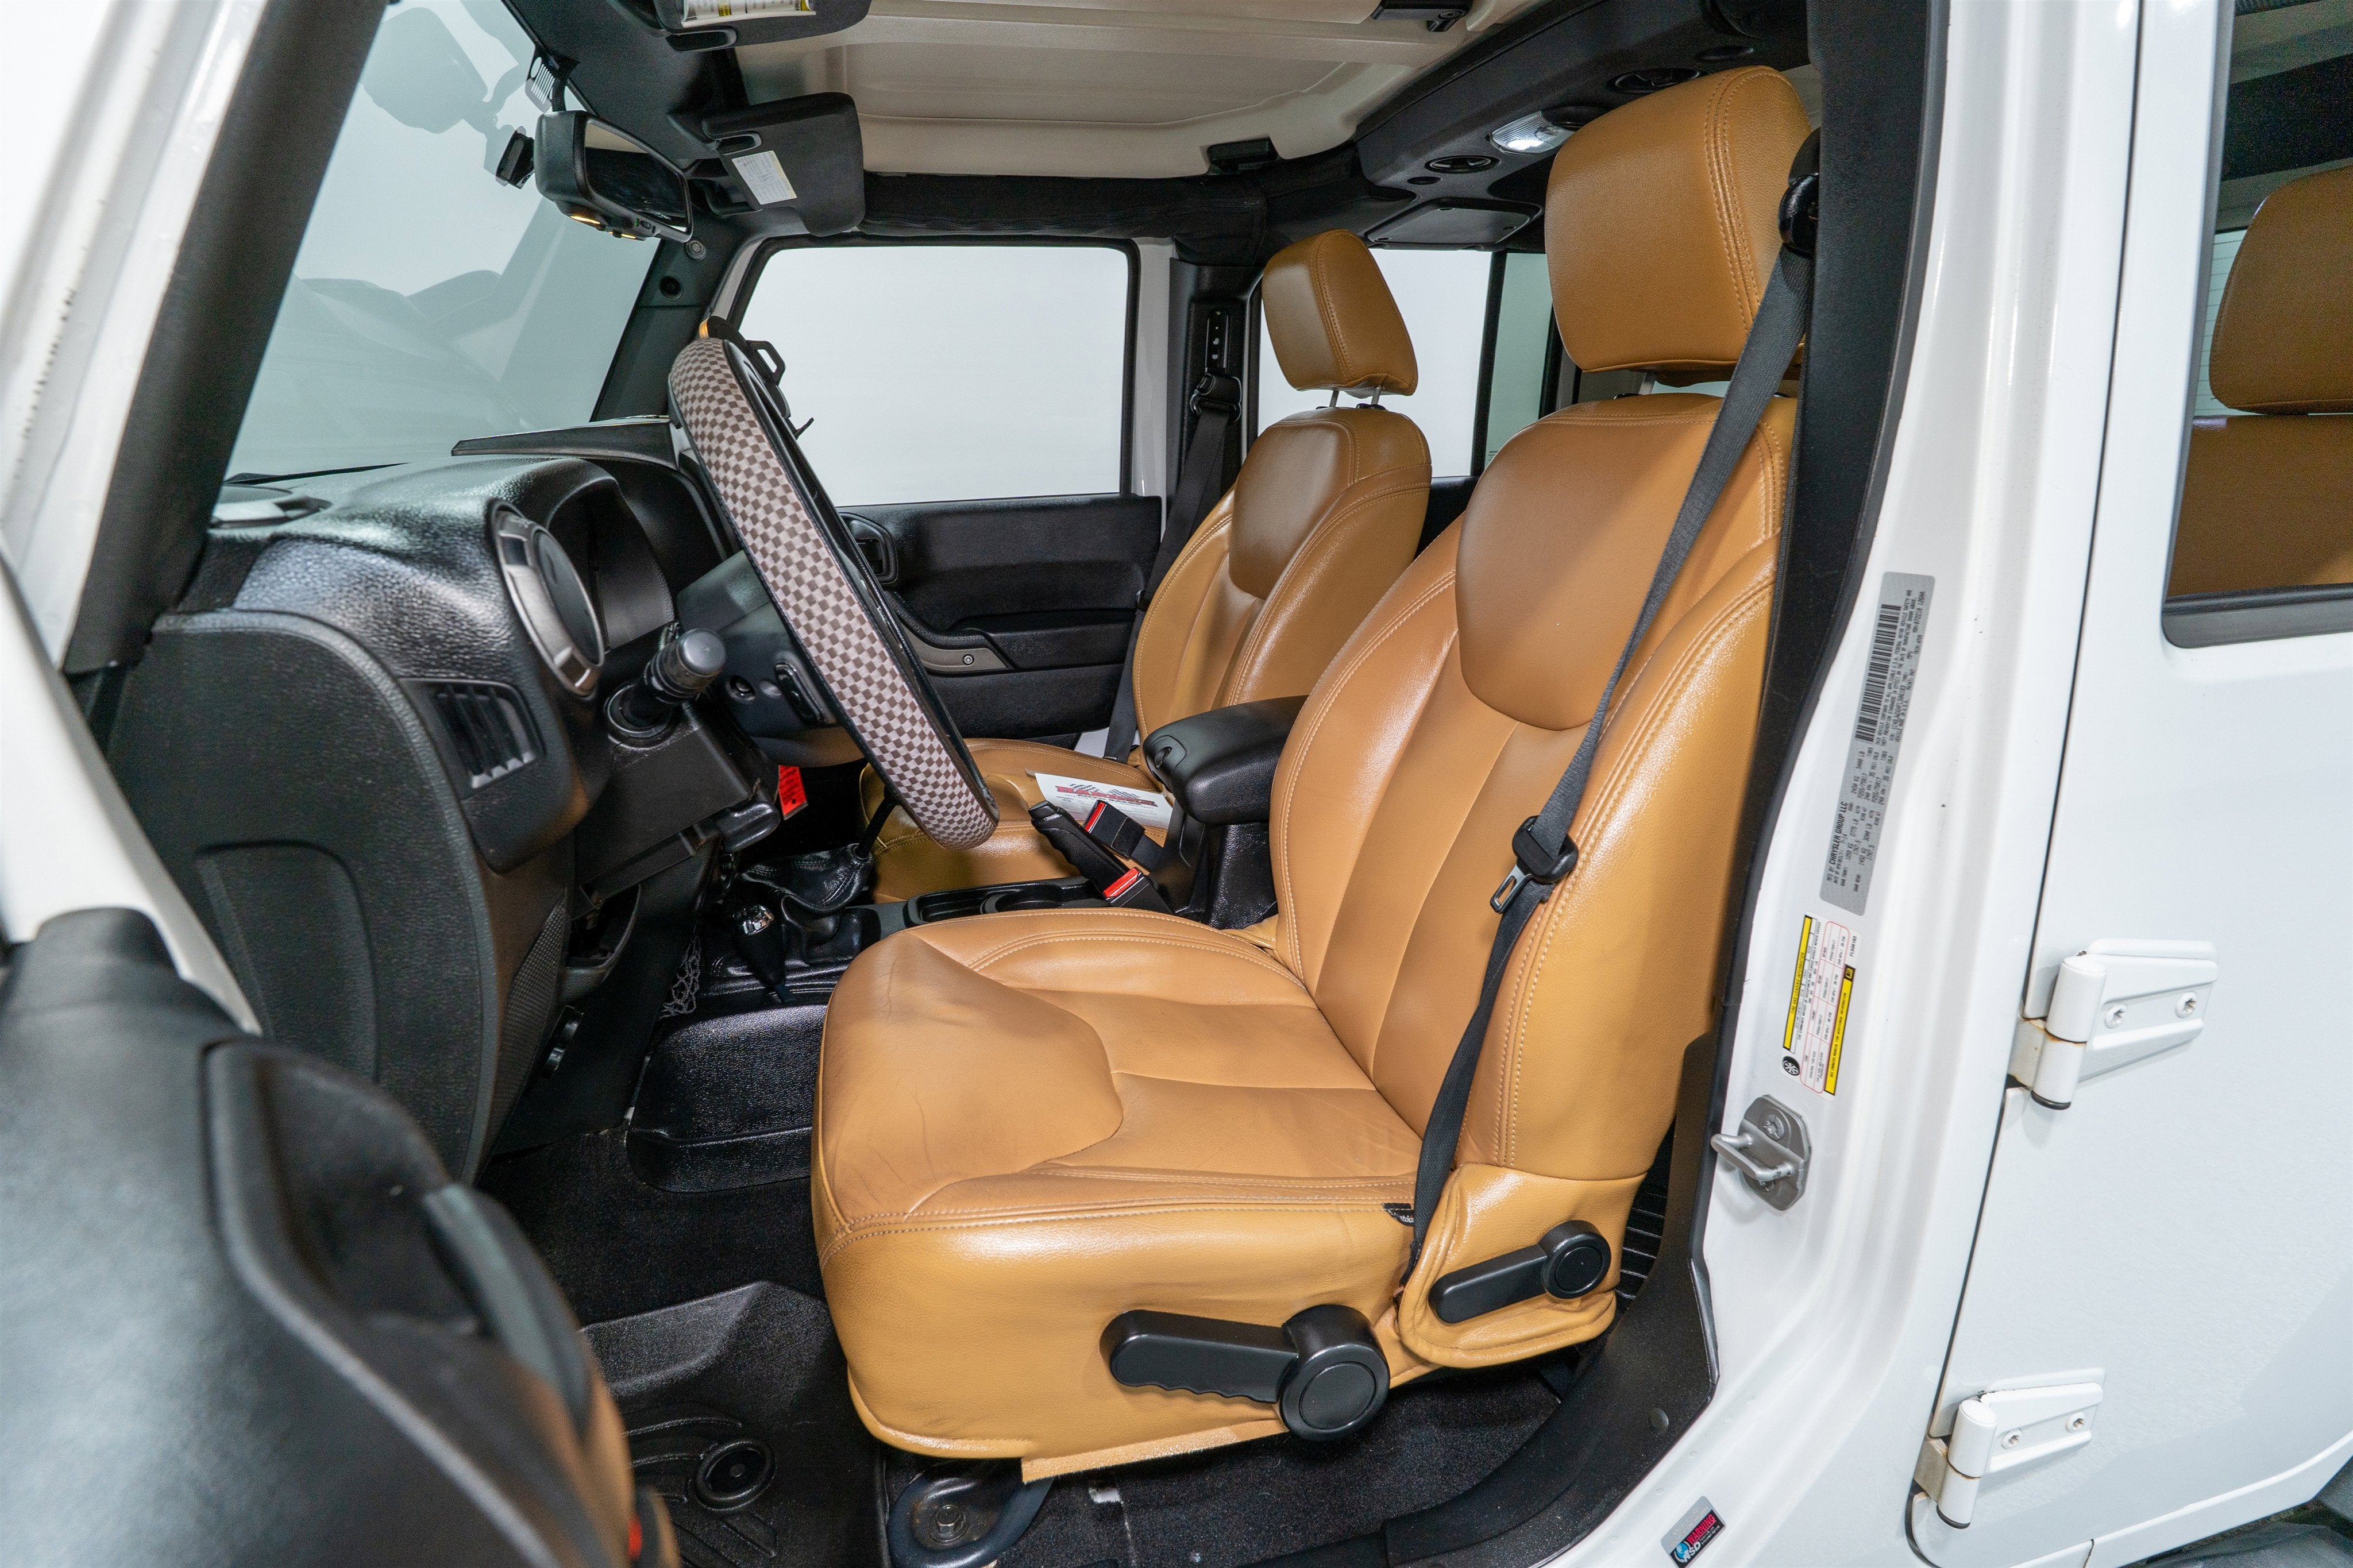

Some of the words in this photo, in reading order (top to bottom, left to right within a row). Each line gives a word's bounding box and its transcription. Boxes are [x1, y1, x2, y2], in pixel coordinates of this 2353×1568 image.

[1839, 801, 1847, 813] LLC
[1835, 813, 1845, 834] GROUP
[1829, 834, 1841, 865] CHRYSLER
[1796, 952, 1804, 979] INFORMATION
[1685, 1513, 1715, 1544] WARNING
